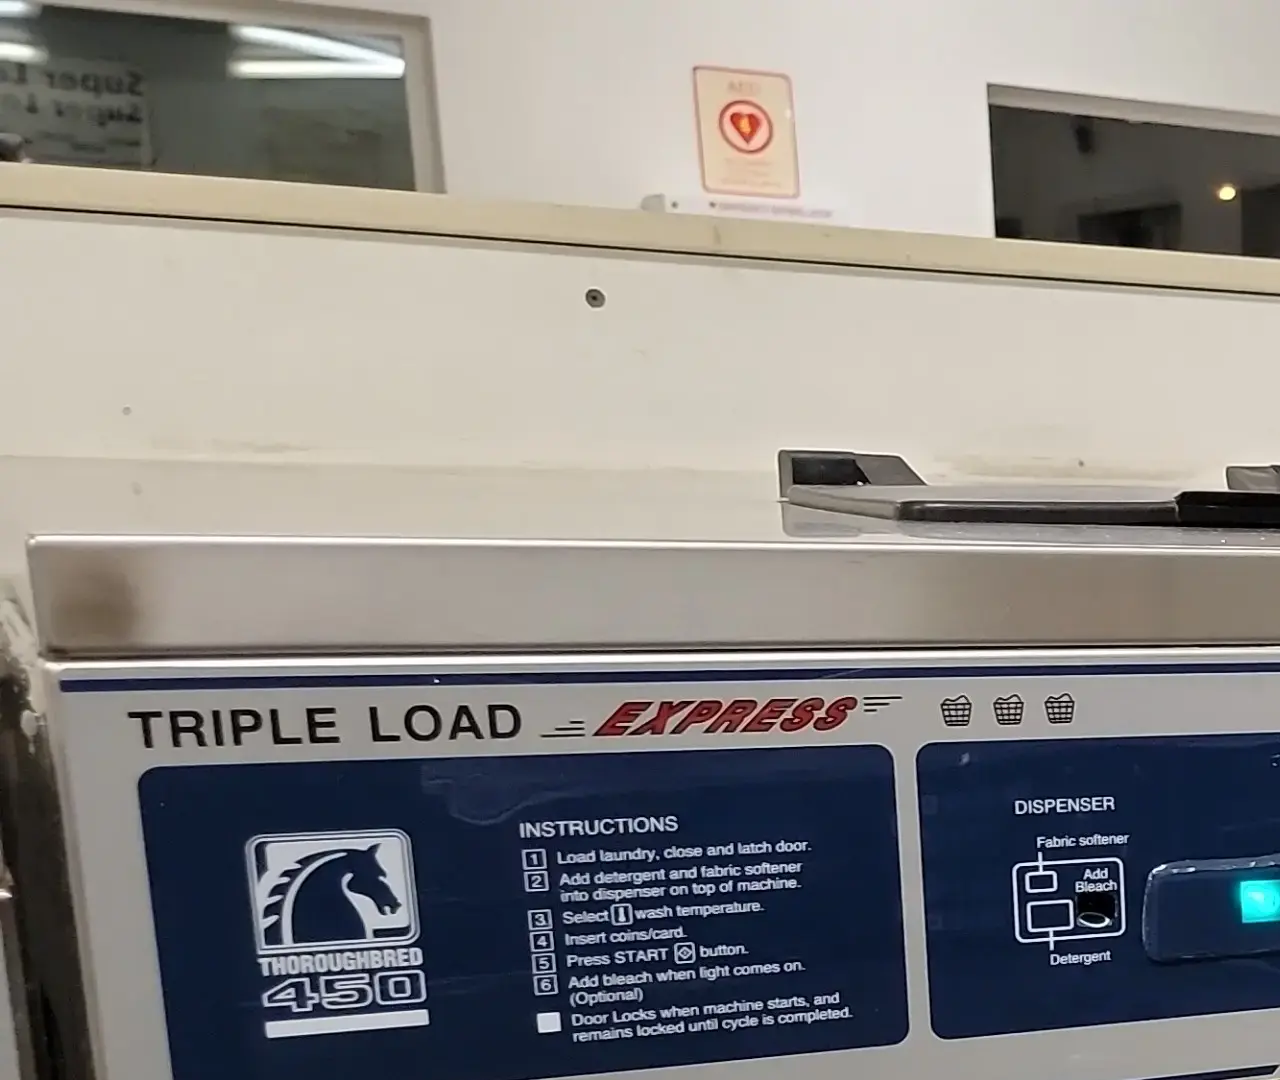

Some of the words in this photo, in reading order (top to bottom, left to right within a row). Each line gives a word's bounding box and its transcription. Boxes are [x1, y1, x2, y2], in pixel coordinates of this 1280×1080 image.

[127, 706, 341, 749] TRIPLE
[368, 703, 522, 743] LOAD
[592, 696, 859, 737] EXPRESS
[1014, 796, 1116, 815] DISPENSER
[519, 815, 679, 839] INSTRUCTIONS
[557, 850, 596, 865] Load
[600, 848, 661, 864] laundry,
[663, 845, 703, 859] close
[706, 843, 734, 857] and
[737, 840, 772, 855] latch
[775, 839, 813, 854] door.
[1036, 835, 1077, 849] Fabric
[1079, 833, 1130, 847] softener
[559, 872, 591, 887] Add
[594, 868, 666, 886] detergent
[669, 866, 698, 880] and
[700, 863, 741, 879] fabric
[744, 861, 804, 876] softener
[1075, 879, 1118, 893] Bleach
[1083, 867, 1109, 881] Add
[560, 889, 590, 903] into
[592, 886, 667, 903] dispenser
[669, 884, 689, 896] on
[692, 881, 717, 897] top
[719, 880, 734, 893] of
[737, 876, 802, 892] machine.
[562, 909, 609, 925] Select
[634, 905, 673, 920] wash
[676, 901, 766, 918] temperature.
[564, 932, 607, 946] Insert
[609, 926, 688, 943] coins/card.
[256, 947, 424, 977] THOROUGHBRED
[566, 953, 611, 968] Press
[614, 948, 669, 964] START
[699, 945, 750, 958] button.
[1050, 950, 1112, 966] Detergent
[568, 974, 599, 989] Add
[602, 970, 653, 987] bleach
[656, 968, 696, 983] when
[699, 965, 731, 981] light
[733, 962, 781, 977] comes
[783, 960, 806, 973] on.
[261, 968, 428, 1012] 450
[569, 987, 644, 1008] (Optional)
[571, 1012, 610, 1027] Door
[612, 1008, 657, 1024] Locks
[660, 1005, 700, 1020] when
[703, 999, 764, 1016] machine
[767, 996, 811, 1010] starts,
[813, 992, 840, 1006] and
[573, 1025, 634, 1043] remains
[636, 1020, 686, 1038] locked
[688, 1017, 719, 1033] until
[721, 1014, 759, 1032] cycle
[762, 1012, 775, 1026] is
[777, 1006, 853, 1025] completed.
